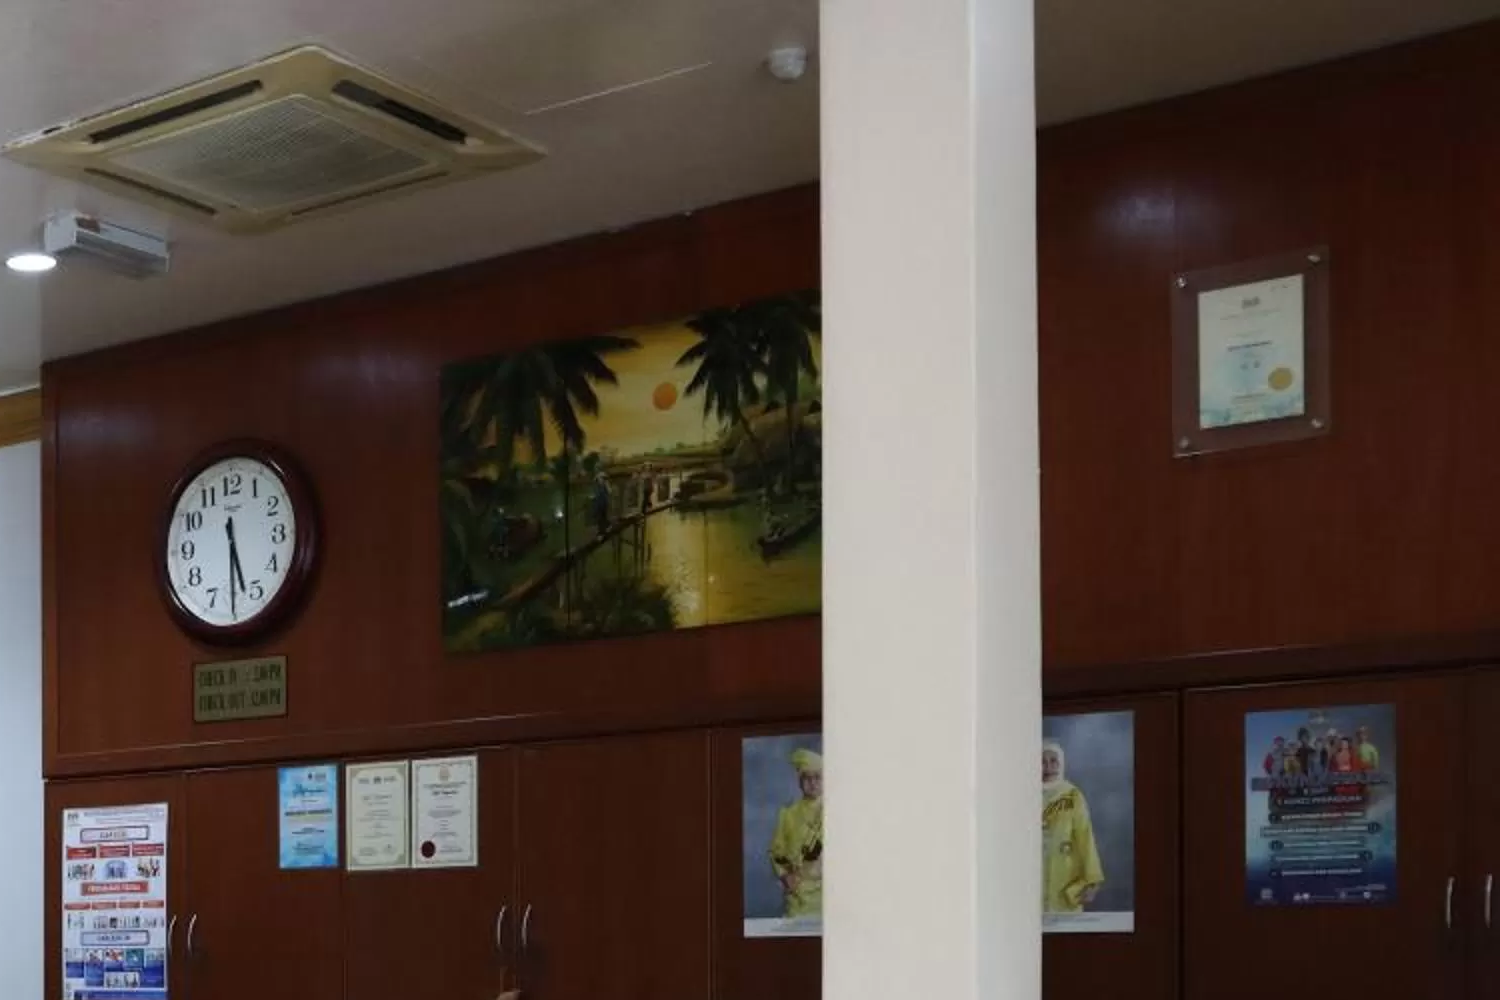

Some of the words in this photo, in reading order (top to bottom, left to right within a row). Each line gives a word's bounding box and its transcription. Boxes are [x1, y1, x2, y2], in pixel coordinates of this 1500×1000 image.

[223, 473, 241, 496] 12
[252, 478, 259, 498] 1
[202, 486, 215, 508] 11
[267, 496, 279, 516] 2
[185, 511, 203, 532] 10
[271, 523, 286, 544] 3
[181, 540, 195, 560] 9
[264, 552, 277, 573] 4
[188, 566, 202, 586] 8
[206, 587, 218, 608] 7
[249, 580, 263, 600] 5
